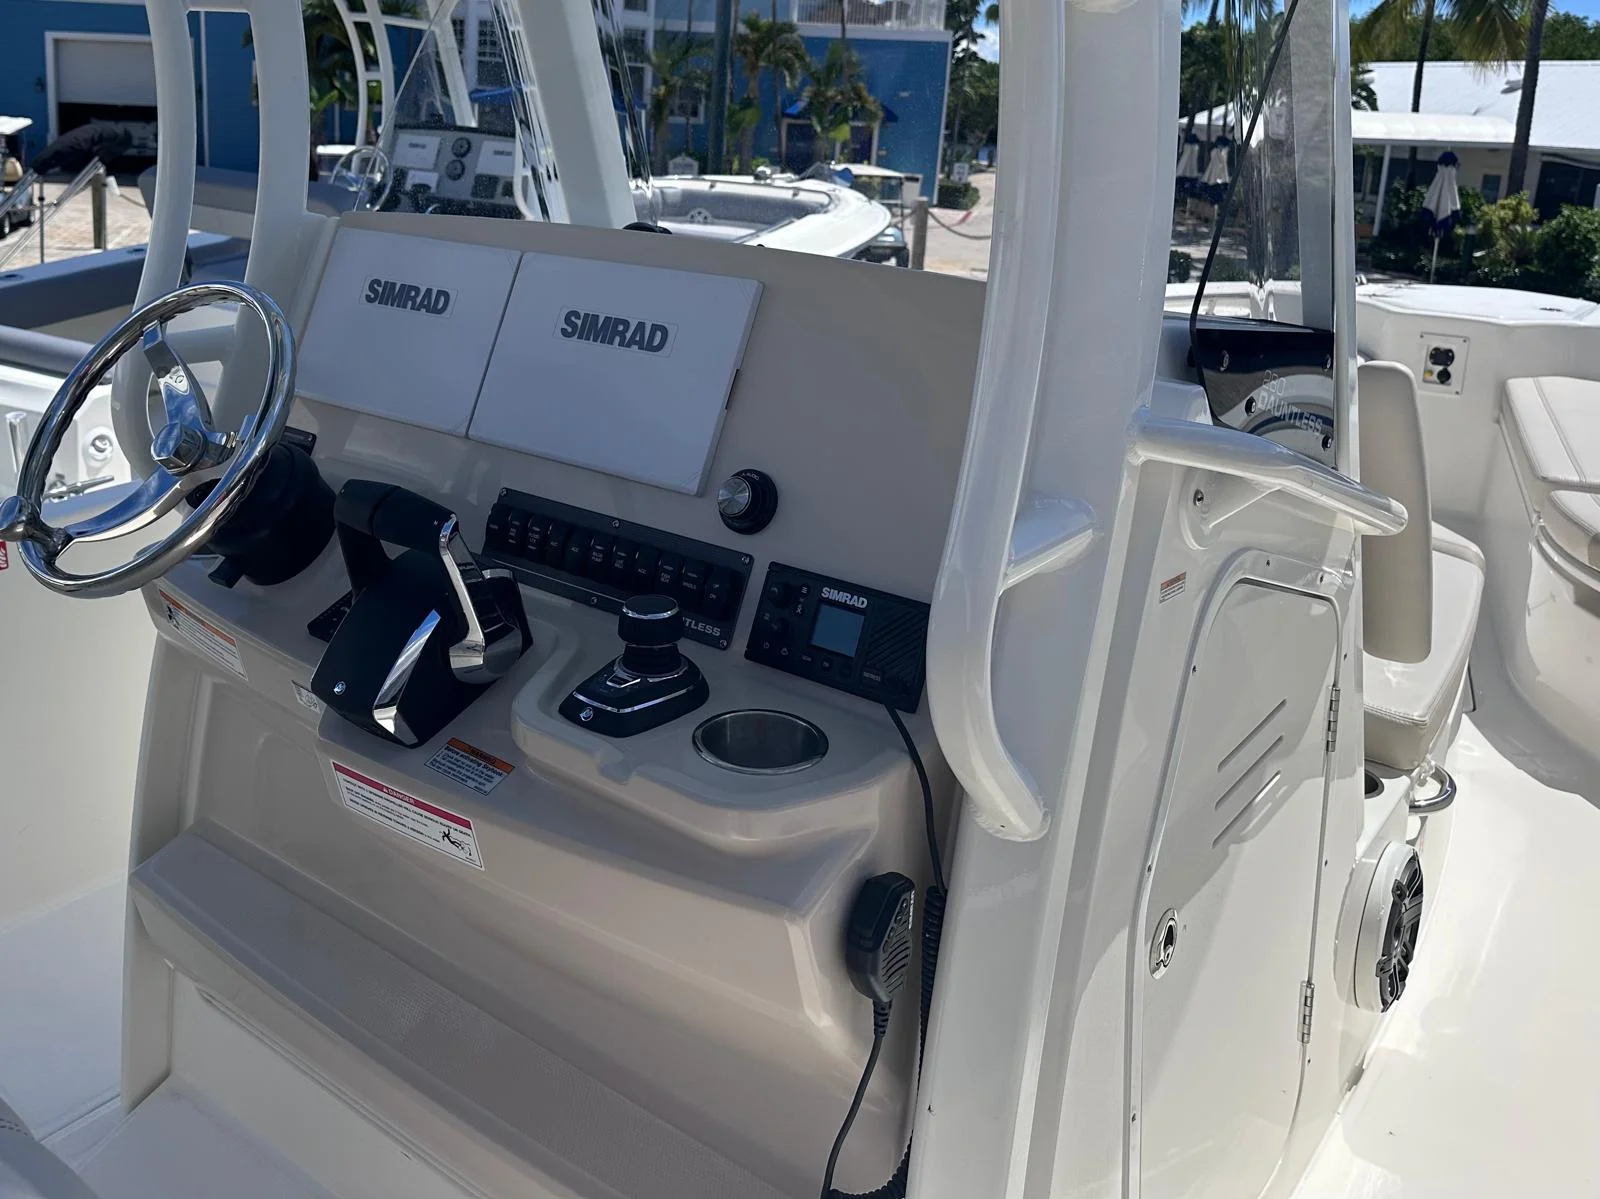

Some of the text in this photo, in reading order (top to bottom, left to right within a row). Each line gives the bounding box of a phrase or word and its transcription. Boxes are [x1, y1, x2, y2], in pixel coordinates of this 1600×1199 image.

[364, 278, 451, 315] SIMRAD
[560, 309, 669, 353] SIMRAD
[1257, 391, 1323, 437] DAUNTLESS
[821, 587, 868, 609] SIMRAD
[388, 789, 415, 805] DANGER
